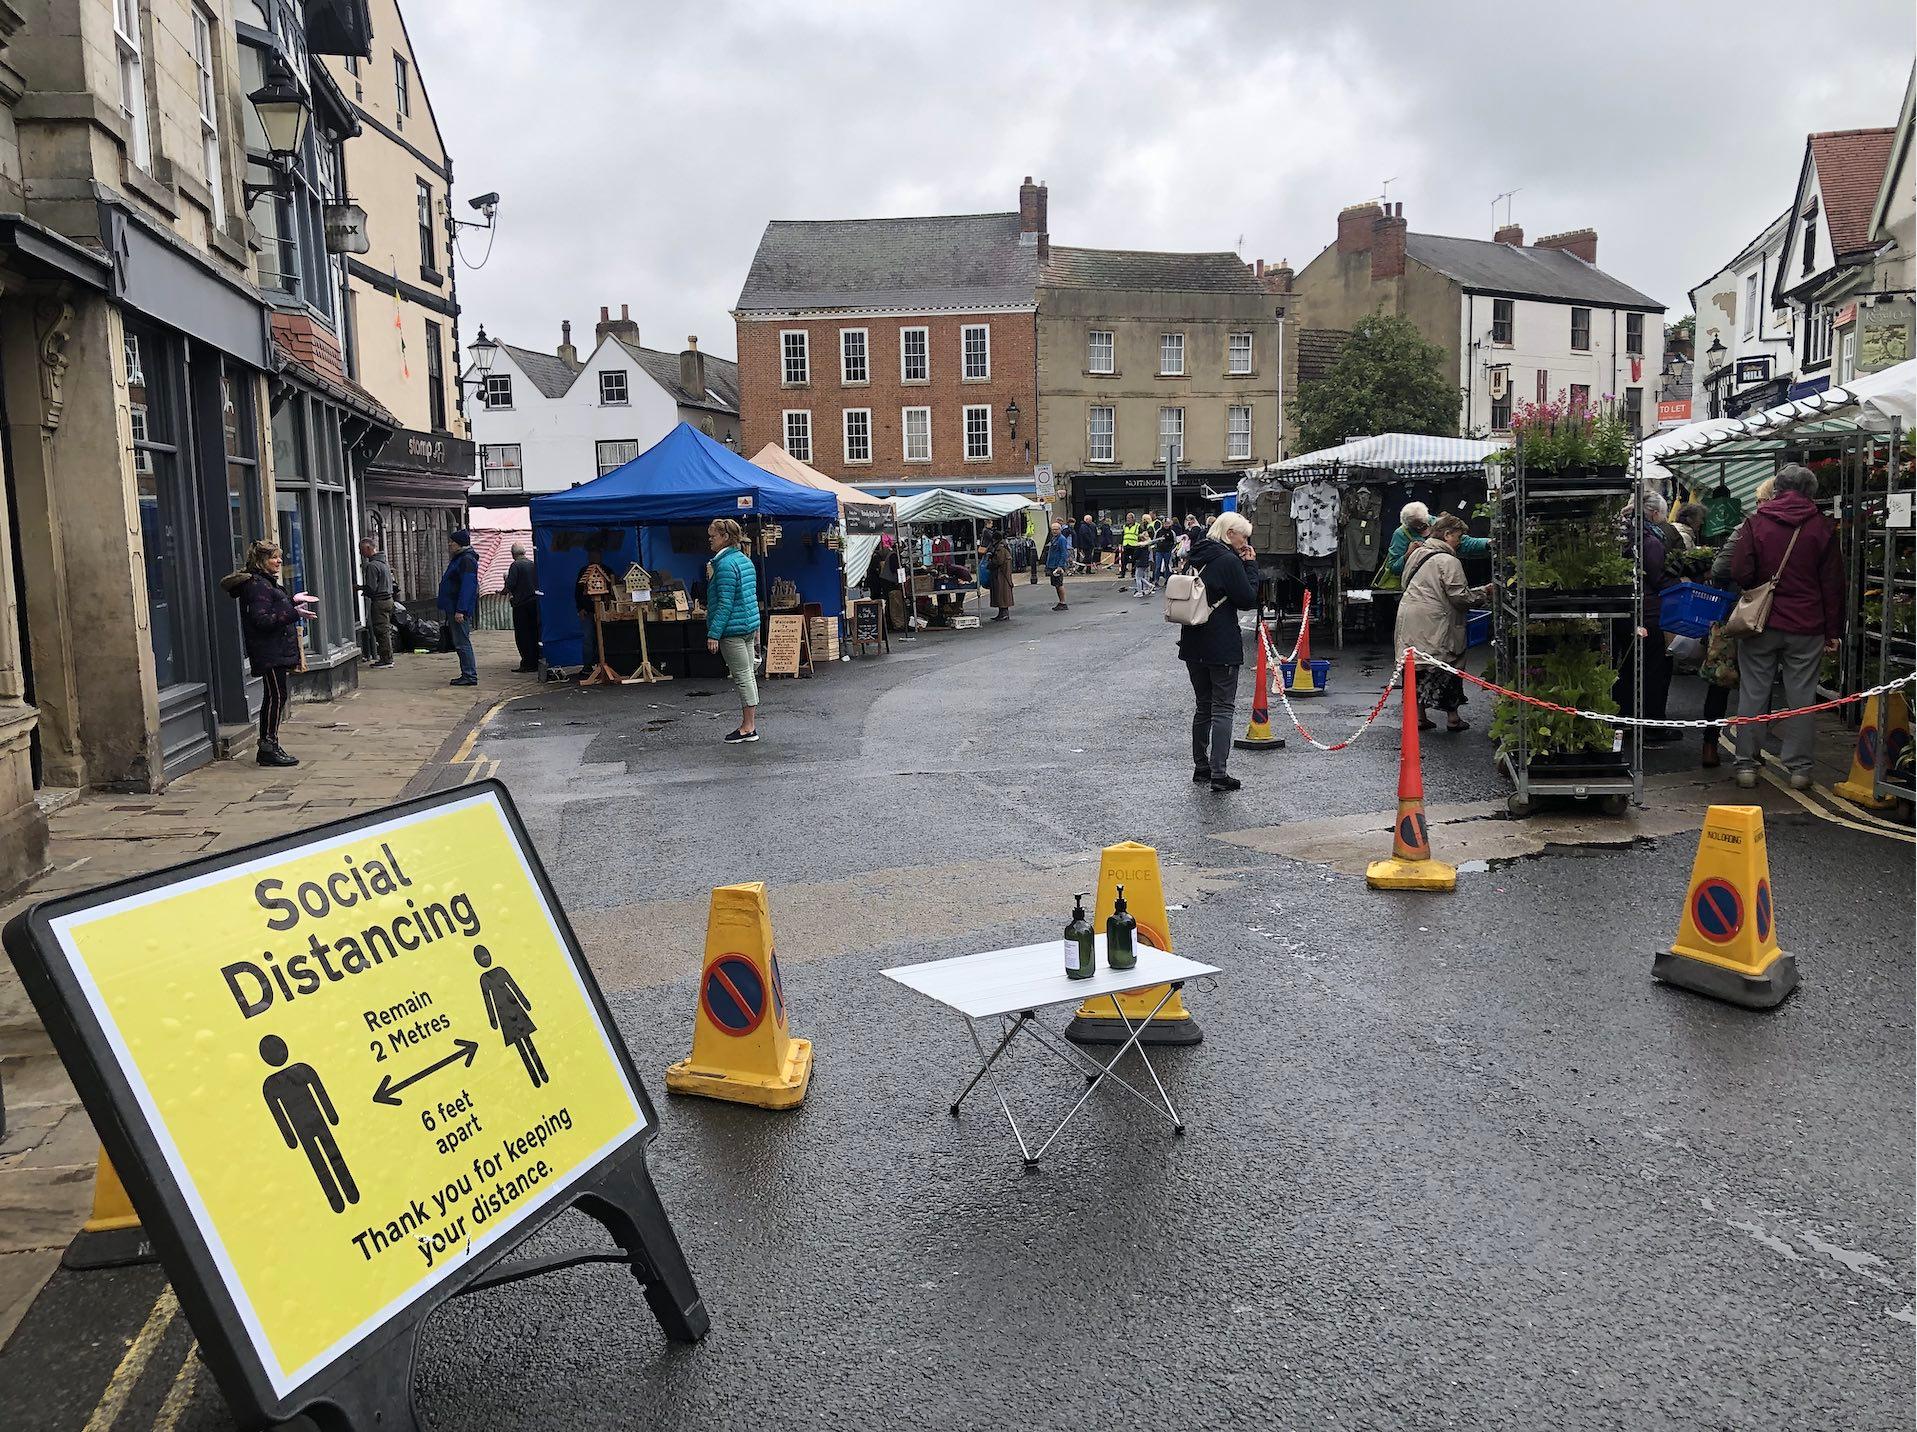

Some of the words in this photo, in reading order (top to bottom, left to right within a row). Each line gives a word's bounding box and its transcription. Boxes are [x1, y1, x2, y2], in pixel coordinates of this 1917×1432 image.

[1743, 370, 1764, 380] HILL
[1660, 405, 1670, 413] TO
[1671, 404, 1686, 413] LET
[408, 436, 433, 463] stomp
[1125, 479, 1168, 487] NOTTINGHA
[255, 843, 413, 931] Social
[1107, 869, 1152, 881] POLICE
[221, 891, 481, 1020] Distancing
[363, 990, 433, 1033] Remain
[370, 1040, 388, 1063] 2
[388, 1013, 451, 1053] Metres
[421, 1110, 436, 1132] 6
[438, 1089, 474, 1123] feet
[436, 1114, 483, 1155] apart
[352, 1200, 432, 1261] Thank
[432, 1173, 473, 1217] you
[474, 1152, 503, 1184] for
[503, 1107, 573, 1163] keeping
[417, 1215, 467, 1267] your
[471, 1159, 554, 1225] distance.
